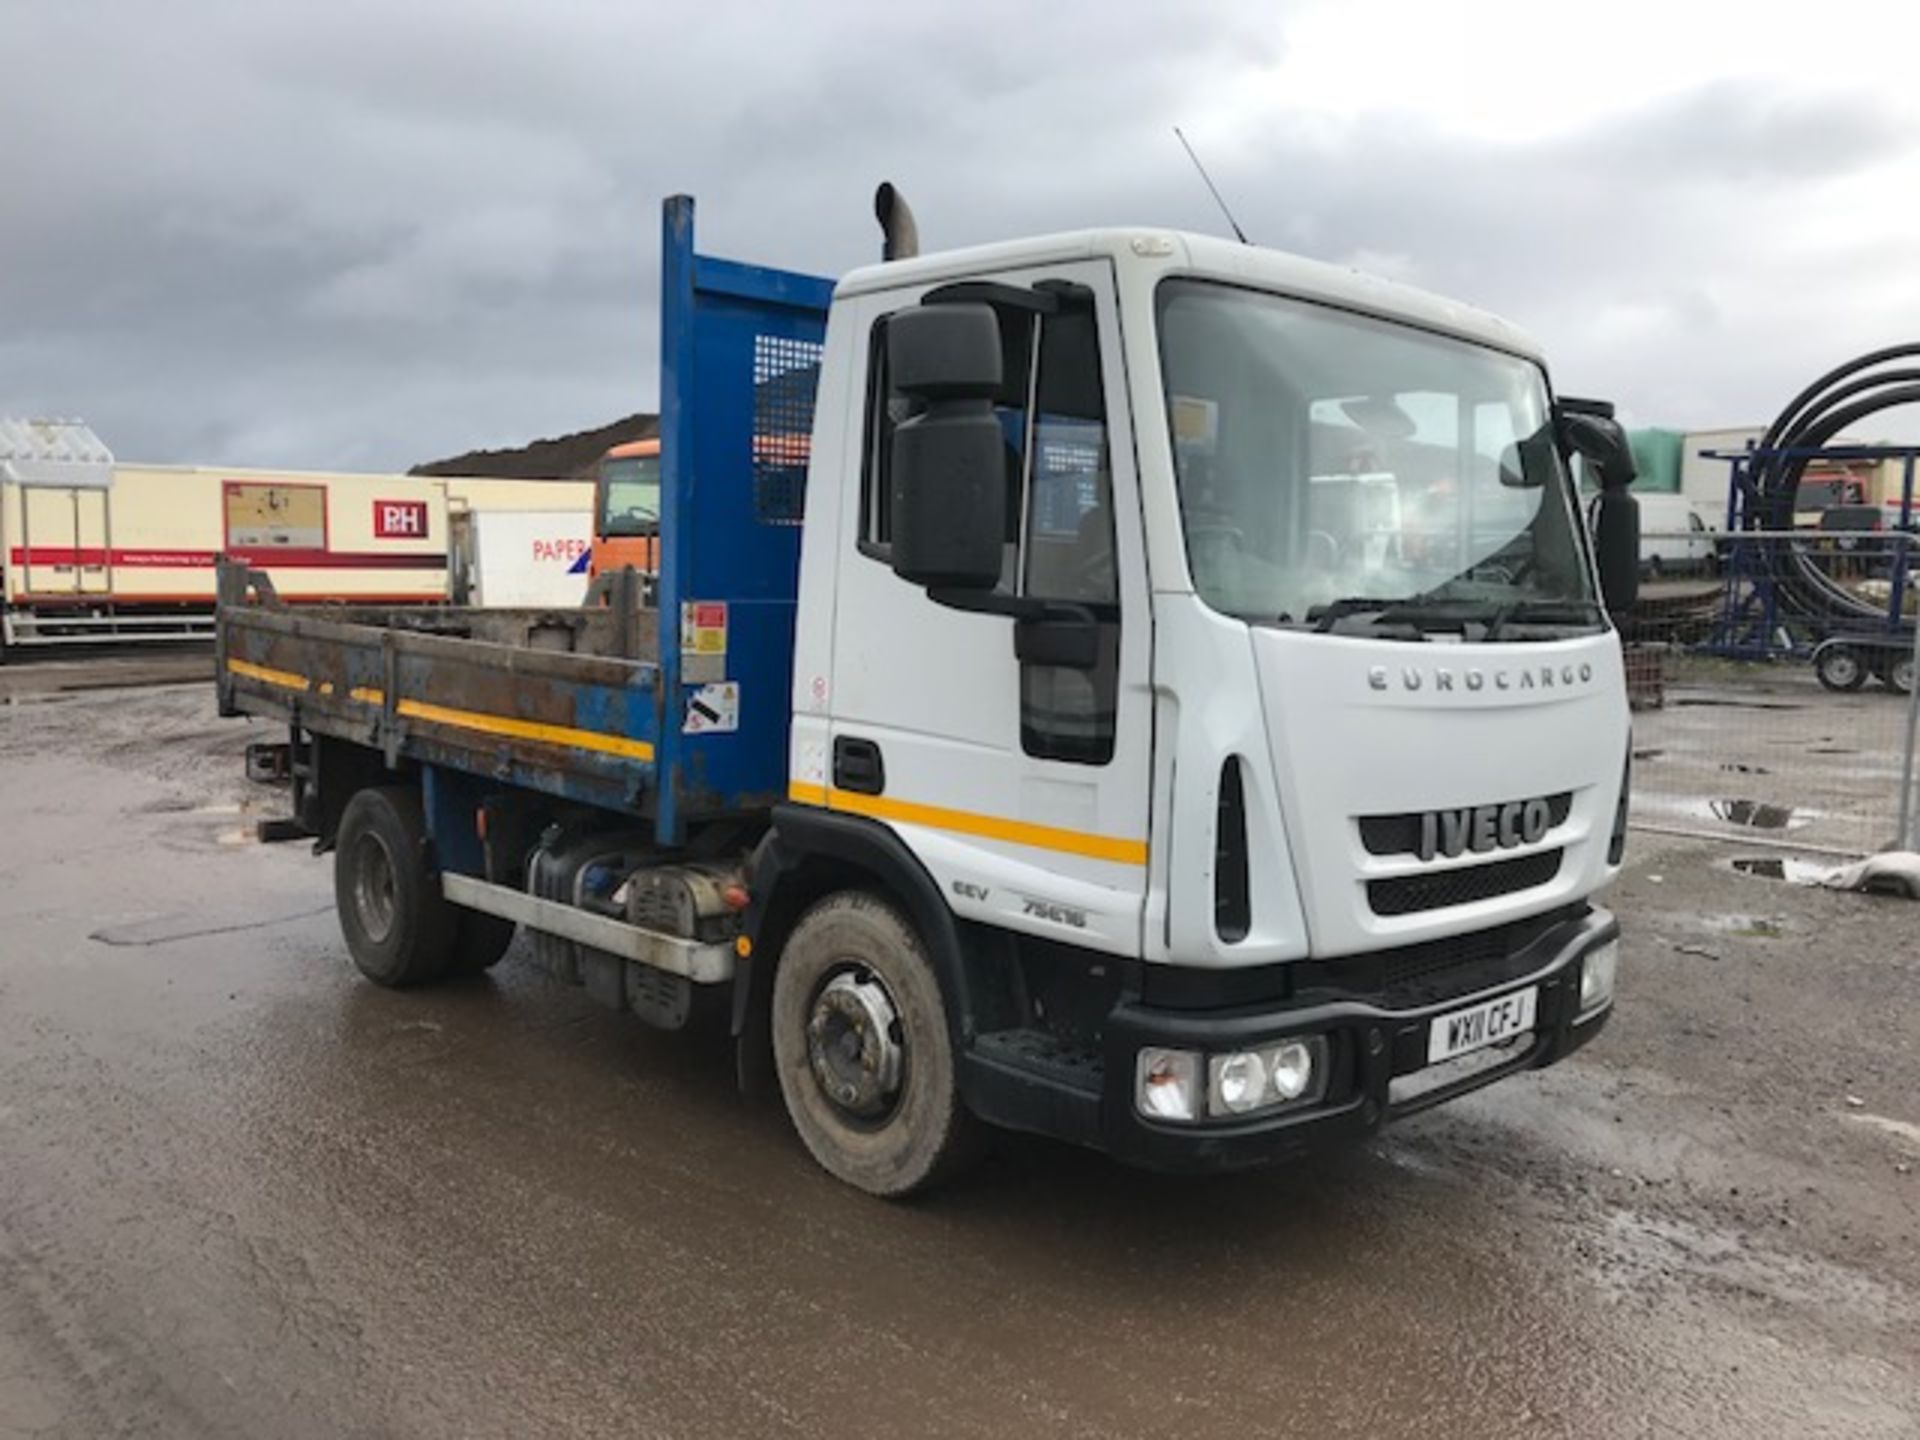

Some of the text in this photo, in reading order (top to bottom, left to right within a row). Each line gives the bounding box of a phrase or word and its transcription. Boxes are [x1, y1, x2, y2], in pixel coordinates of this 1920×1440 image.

[1367, 663, 1593, 692] EUROCARGO
[1419, 800, 1550, 862] IVECO
[952, 880, 990, 901] EEV
[1447, 995, 1526, 1052] WX11 CFJ
